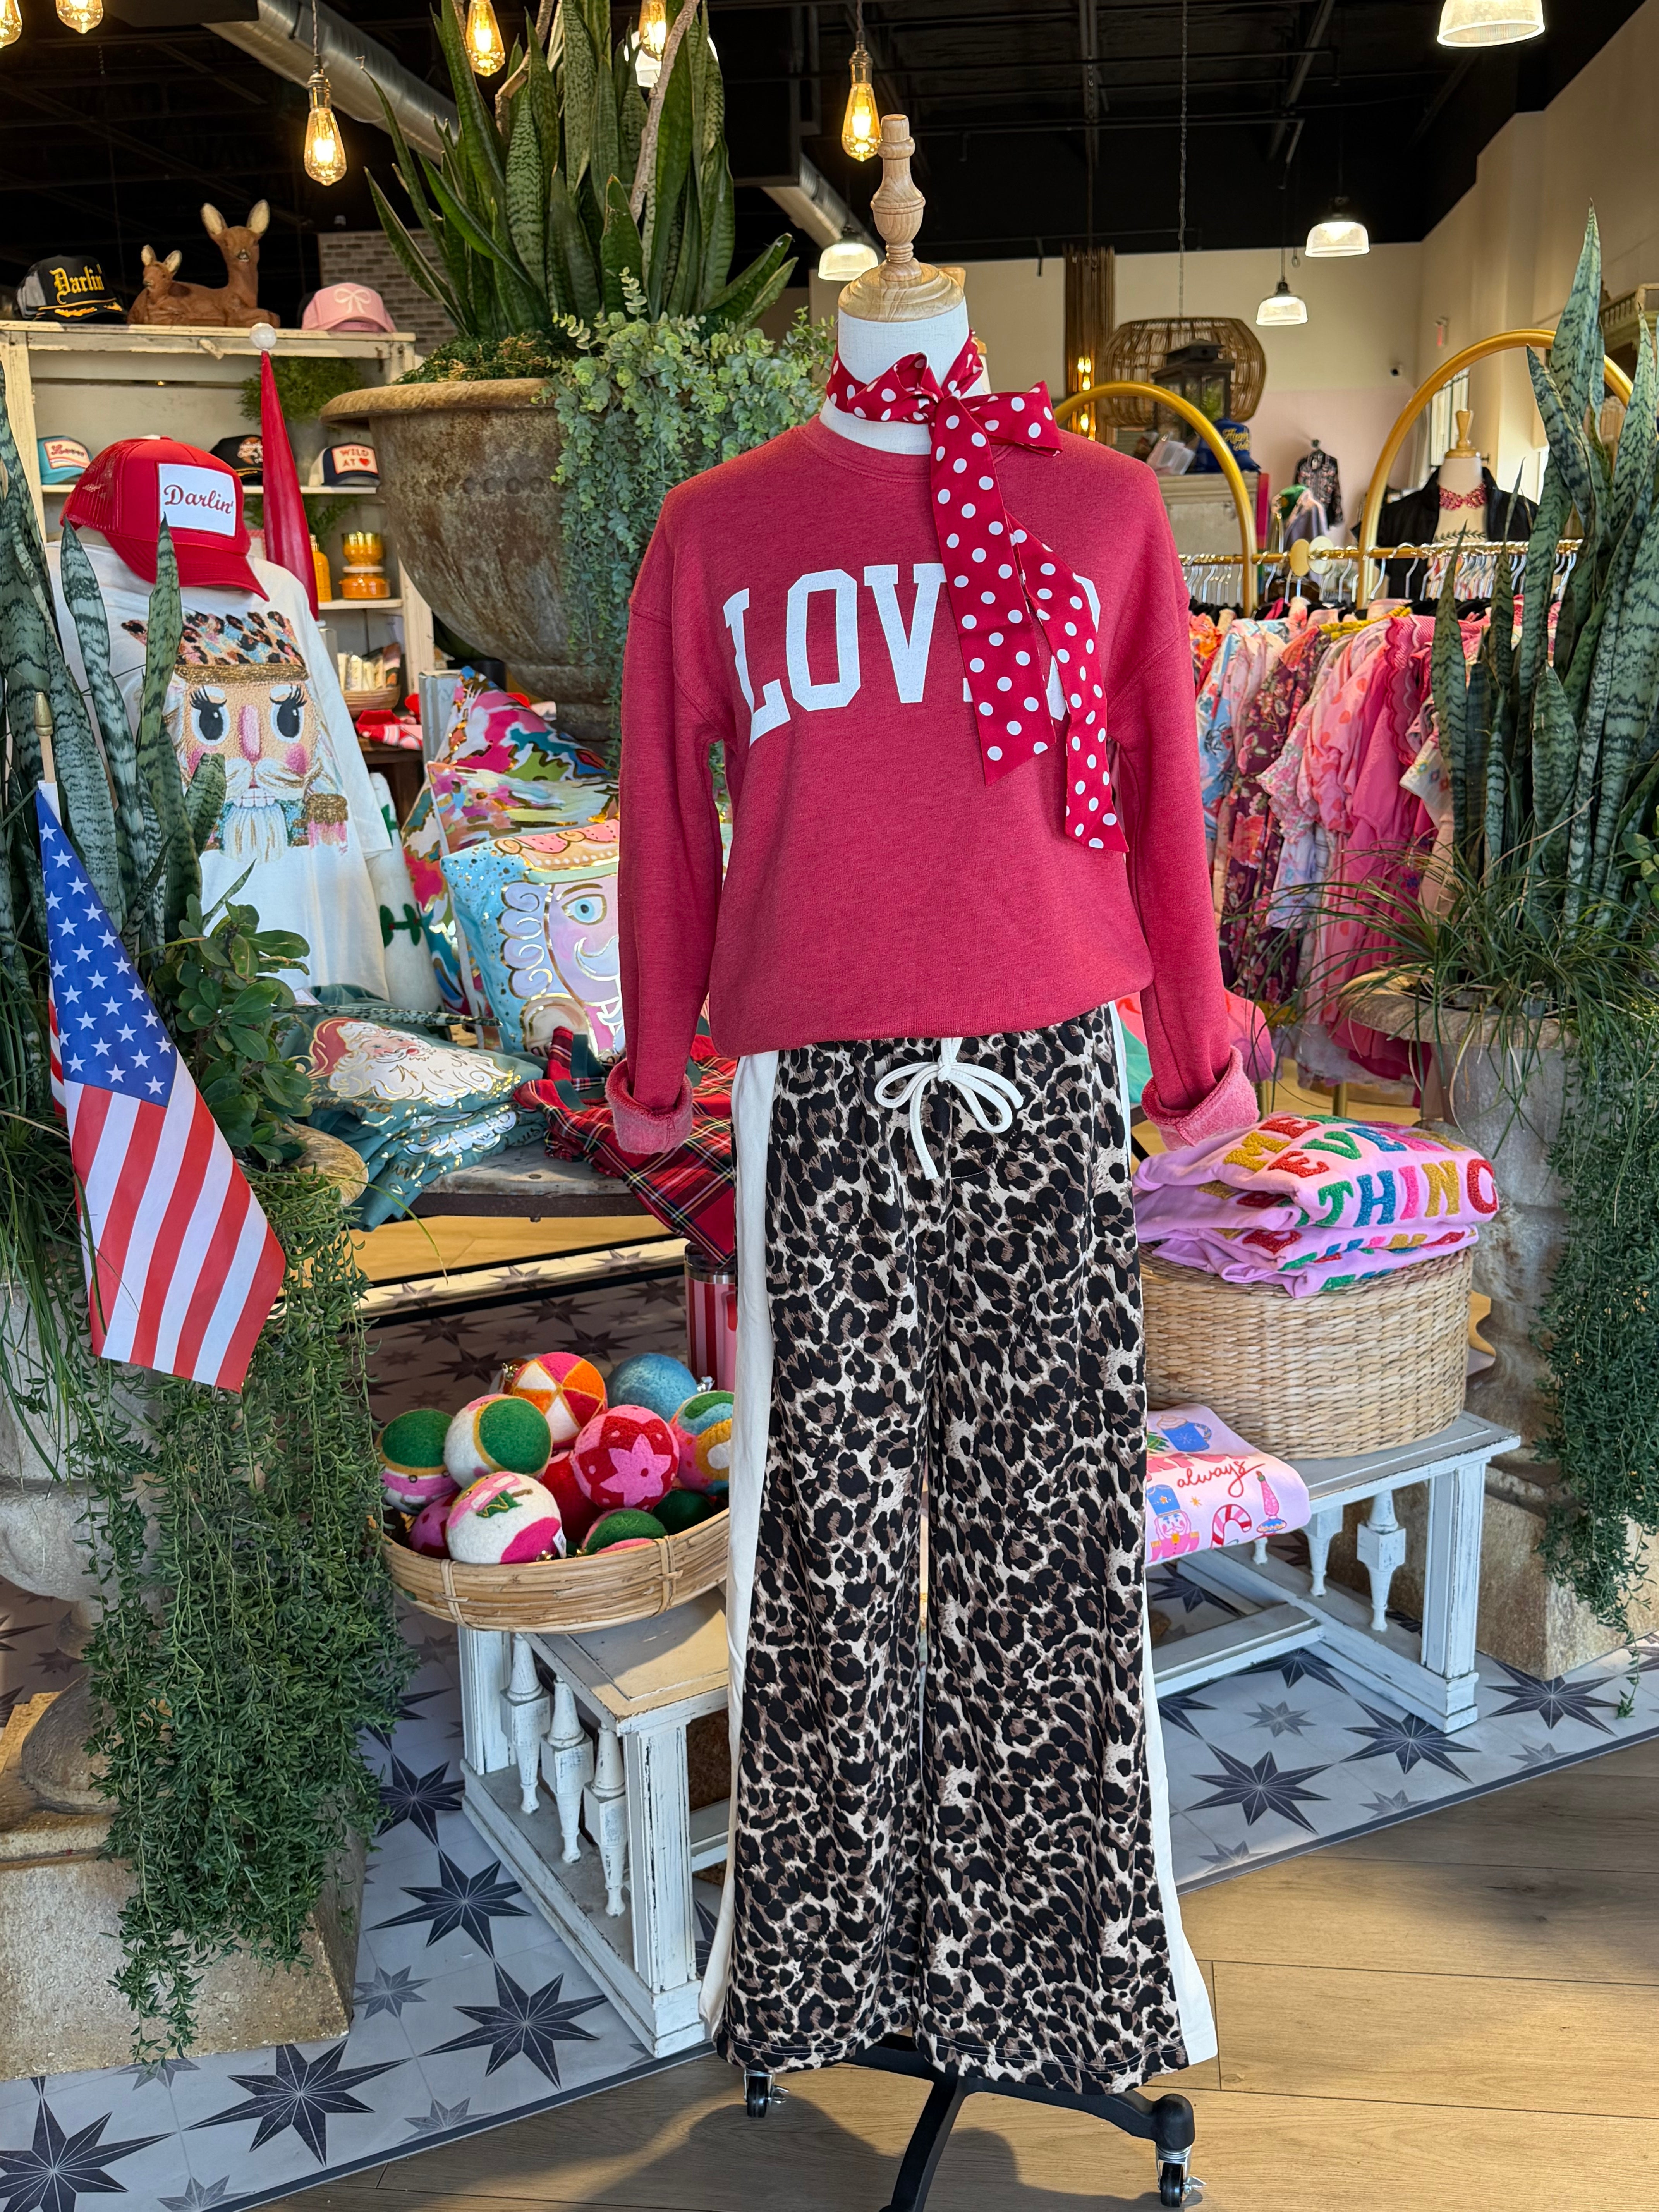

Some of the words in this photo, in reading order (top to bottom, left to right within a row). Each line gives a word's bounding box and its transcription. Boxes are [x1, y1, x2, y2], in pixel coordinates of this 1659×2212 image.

[49, 264, 105, 305] Darlin'
[342, 459, 356, 467] AT
[163, 484, 234, 514] Darlin'
[723, 563, 1101, 748] LOV
[1177, 1460, 1265, 1498] always
